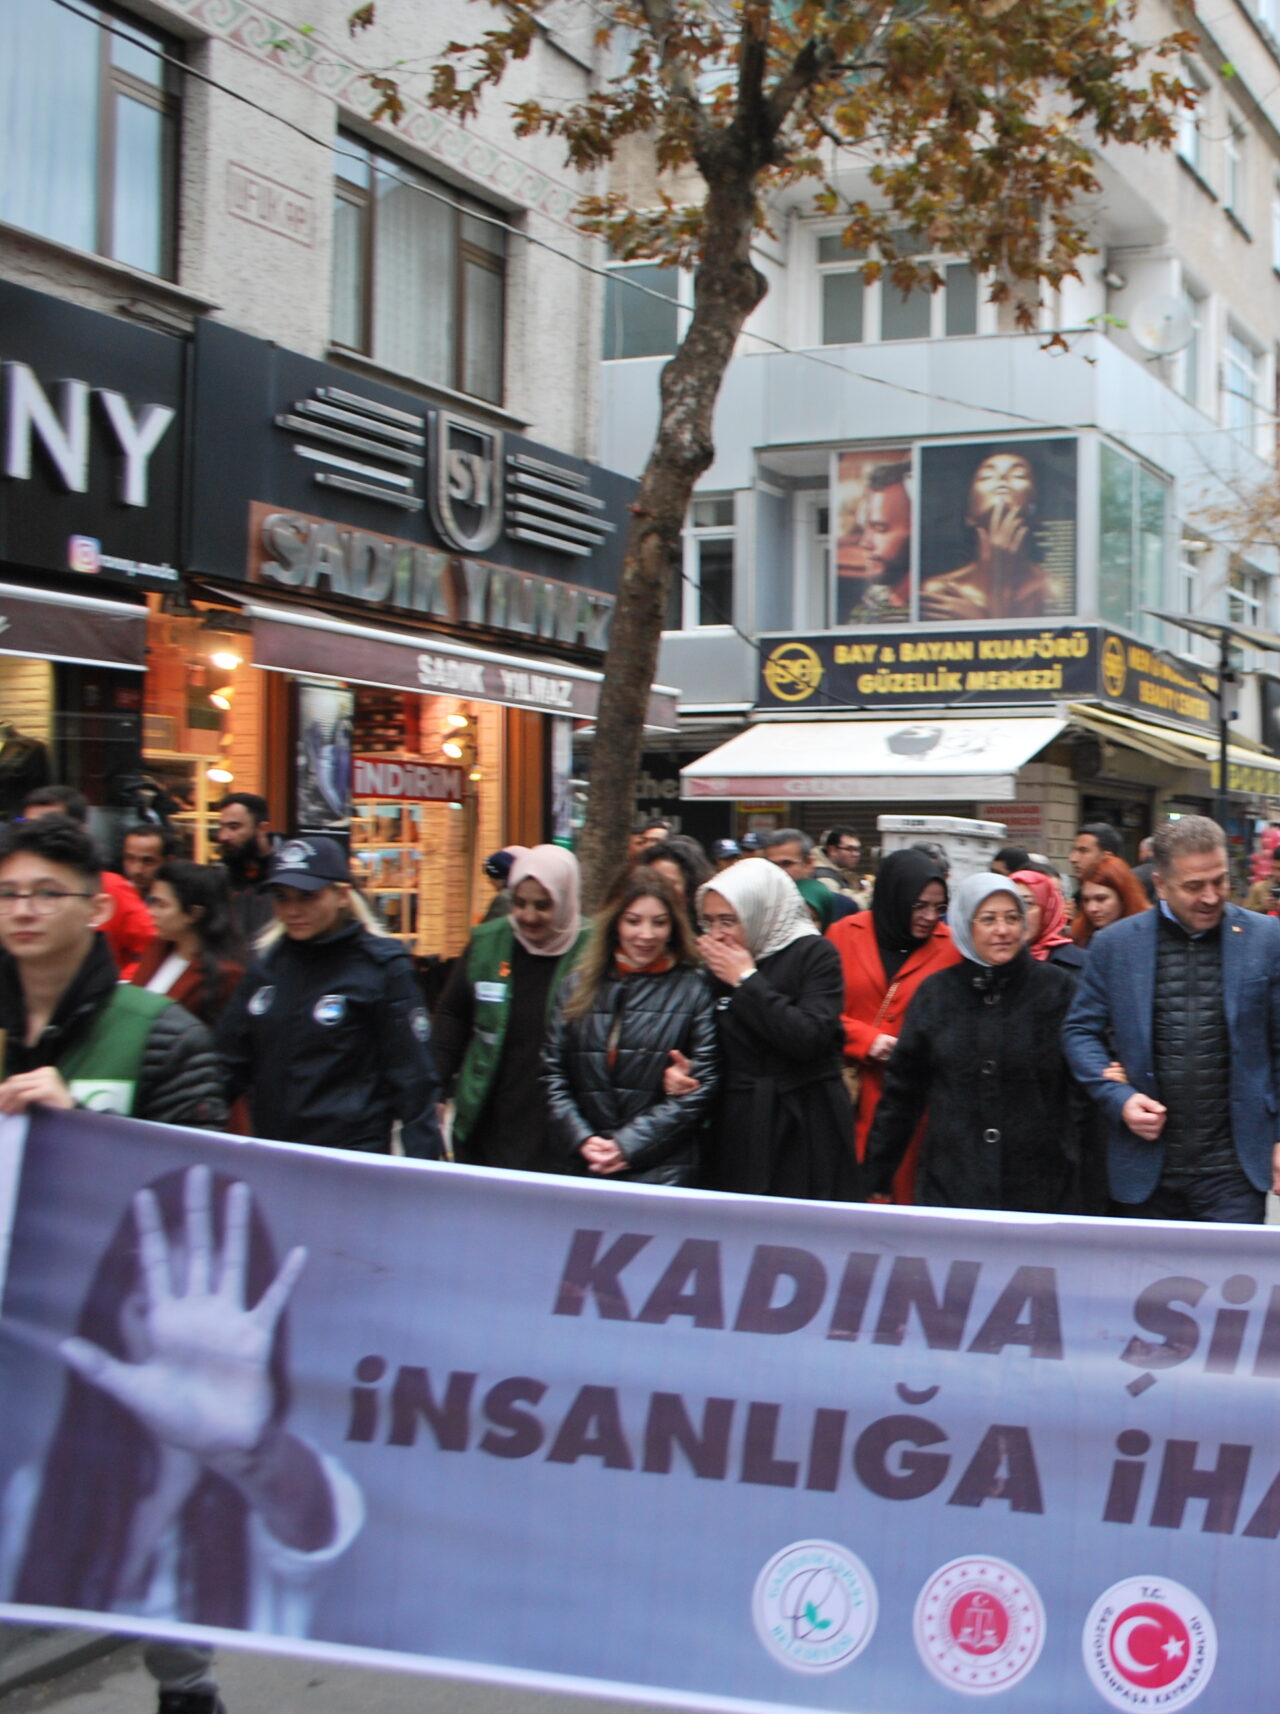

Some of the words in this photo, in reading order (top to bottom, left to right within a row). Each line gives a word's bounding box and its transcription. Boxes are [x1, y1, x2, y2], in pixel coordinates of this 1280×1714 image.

[262, 513, 450, 617] SADIK
[417, 653, 485, 692] SADIK
[500, 669, 573, 708] YILMAZ
[834, 644, 877, 664] BAY
[879, 647, 896, 663] &
[899, 641, 974, 662] BAYAN
[978, 632, 1088, 659] KUAFÖRÜ
[857, 667, 963, 694] GÜZELLİK
[965, 664, 1063, 692] MERKEZİ
[551, 1228, 1065, 1361] KADINA
[345, 1354, 1045, 1515] İNSANLIĞA
